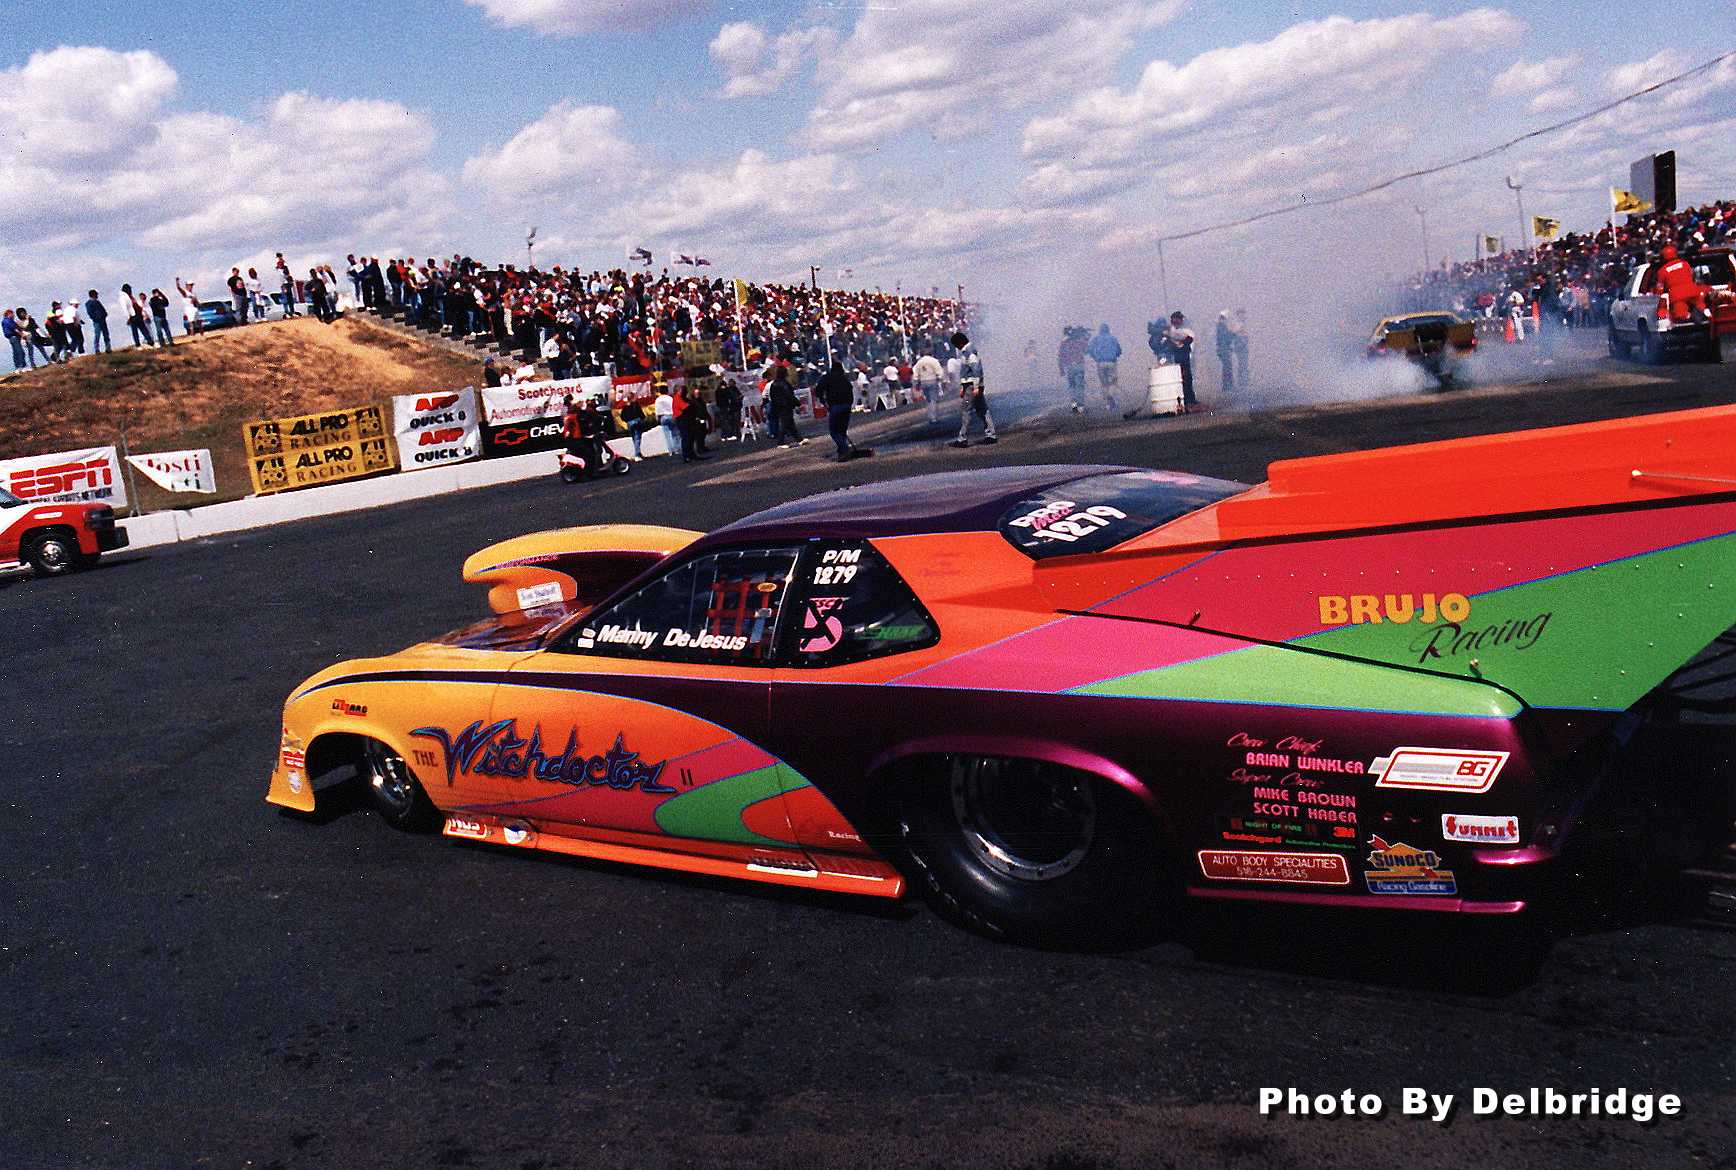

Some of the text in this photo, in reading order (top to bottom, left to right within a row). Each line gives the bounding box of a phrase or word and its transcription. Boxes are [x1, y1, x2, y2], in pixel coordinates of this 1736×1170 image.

[518, 383, 582, 400] Scotchgard
[290, 413, 349, 435] ALL PRO
[410, 412, 454, 429] QUICK
[290, 430, 352, 449] RACING
[530, 423, 564, 438] CHEV
[296, 446, 353, 468] ALL PRO
[415, 448, 459, 463] QUICK
[10, 459, 112, 498] ESPN
[296, 463, 357, 481] RACING
[1032, 505, 1128, 542] 1279
[822, 549, 862, 564] P/M
[813, 565, 858, 585] 1279
[1318, 592, 1472, 625] BRUJO
[597, 623, 658, 650] Manny
[1408, 611, 1553, 664] Racing
[408, 717, 678, 794] Witchdoctor
[412, 749, 438, 768] THE
[1246, 751, 1364, 775] BRIAN WINKLER
[1457, 760, 1490, 777] BG
[1253, 786, 1356, 809] MIKE BROWN
[1253, 802, 1357, 824] SCOTT HABER
[827, 830, 862, 842] Racing
[1212, 855, 1238, 866] AUTO
[1242, 856, 1268, 868] BODY
[1373, 851, 1437, 868] SUNOCO
